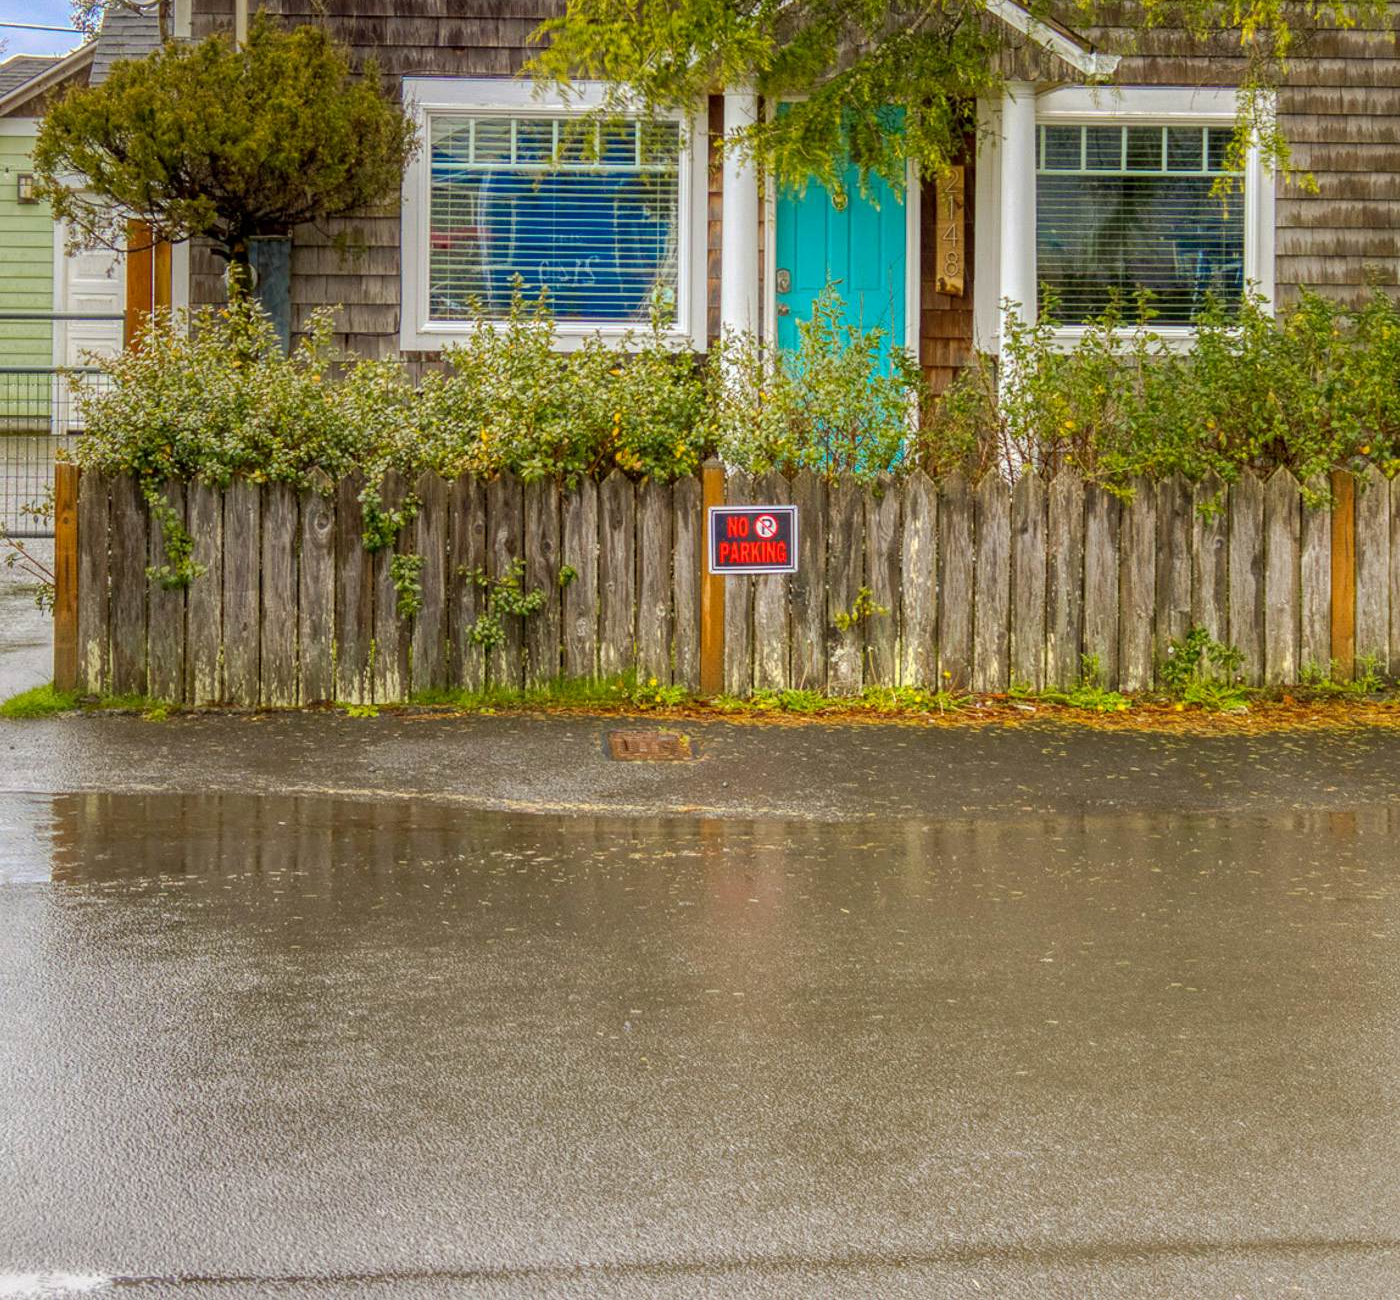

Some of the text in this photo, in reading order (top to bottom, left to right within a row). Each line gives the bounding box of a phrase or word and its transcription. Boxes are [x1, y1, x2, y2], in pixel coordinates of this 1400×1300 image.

[943, 167, 960, 278] 2148
[727, 515, 750, 538] NO
[719, 540, 788, 564] PARKING
